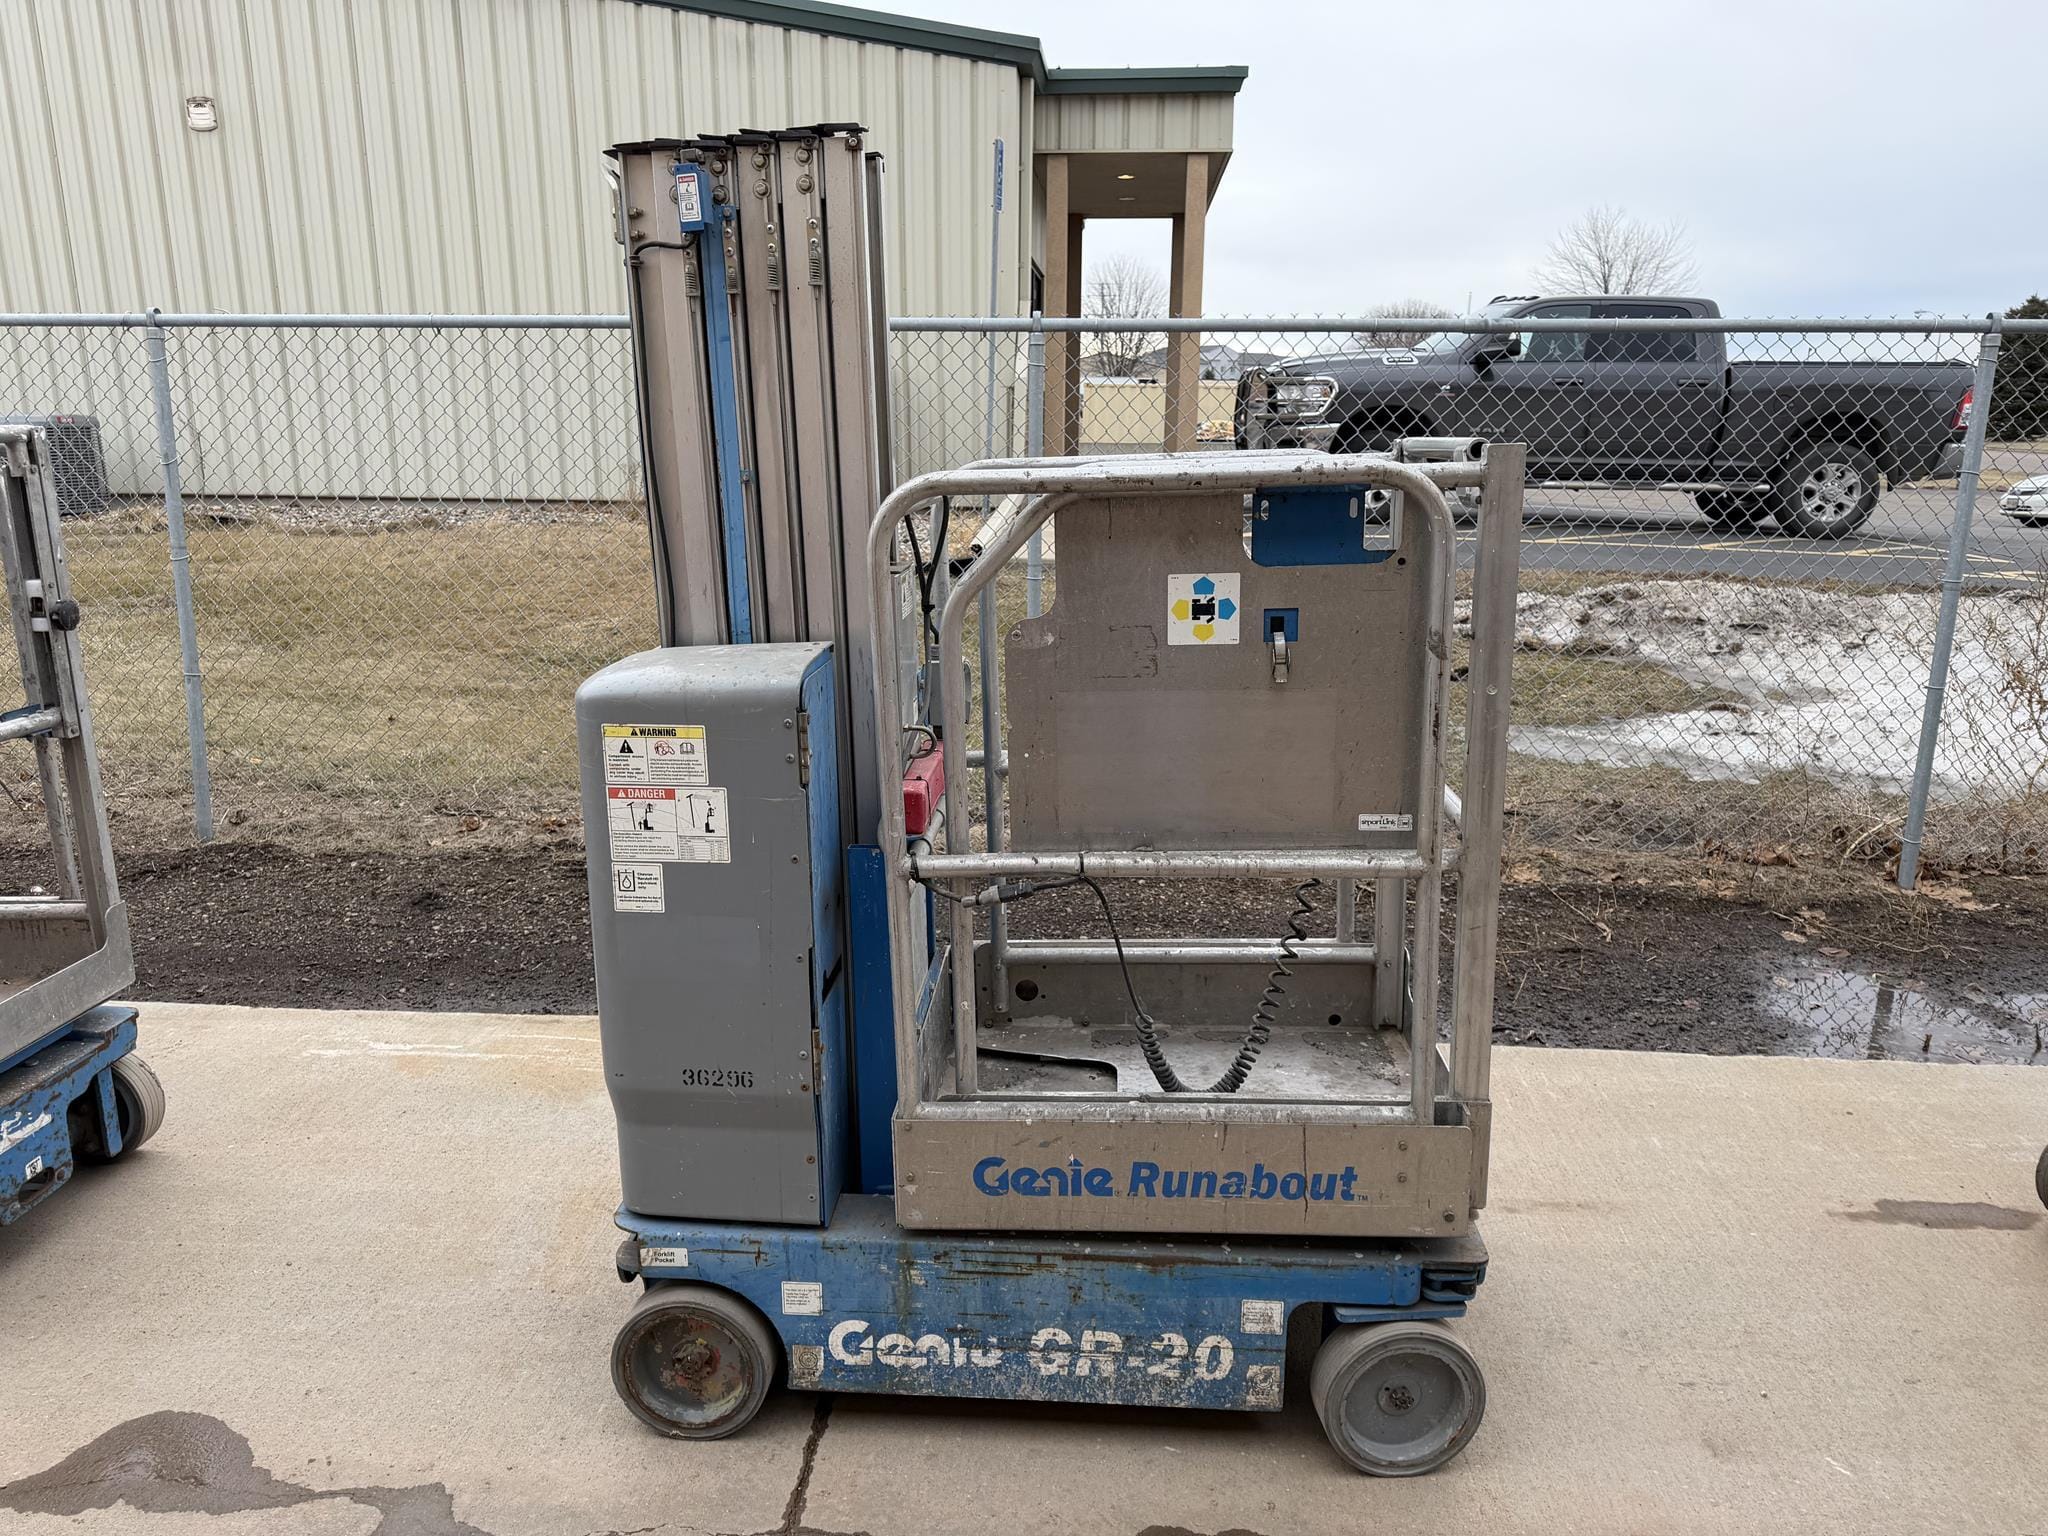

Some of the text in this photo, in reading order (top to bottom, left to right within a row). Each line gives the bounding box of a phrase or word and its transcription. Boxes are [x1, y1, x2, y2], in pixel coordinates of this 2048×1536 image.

[639, 728, 677, 737] WARNING
[628, 788, 666, 799] DANGER
[682, 1068, 753, 1088] 36296
[972, 1156, 1114, 1197] Genie
[1129, 1161, 1359, 1201] Runabout
